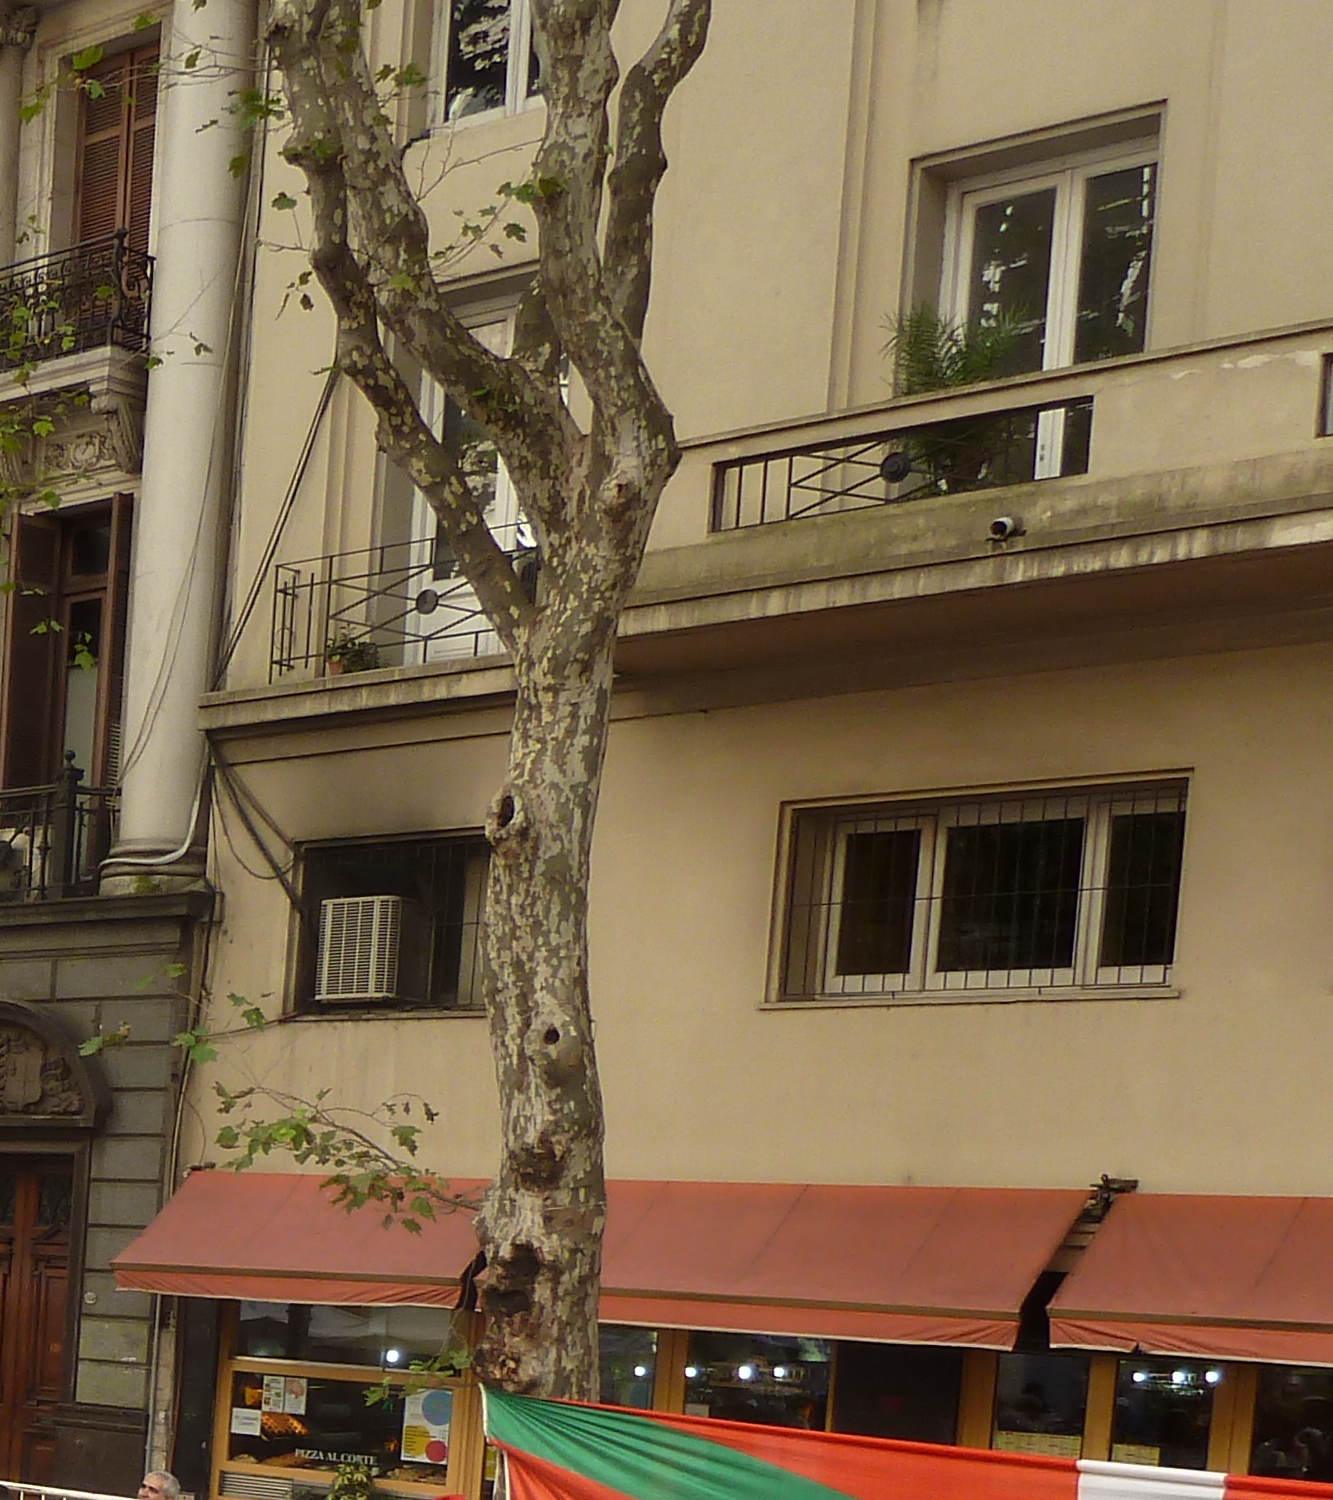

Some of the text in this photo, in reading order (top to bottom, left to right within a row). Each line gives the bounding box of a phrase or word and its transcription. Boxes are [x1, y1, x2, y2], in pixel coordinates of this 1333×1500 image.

[294, 1448, 378, 1466] PIZZA AL CORTE
